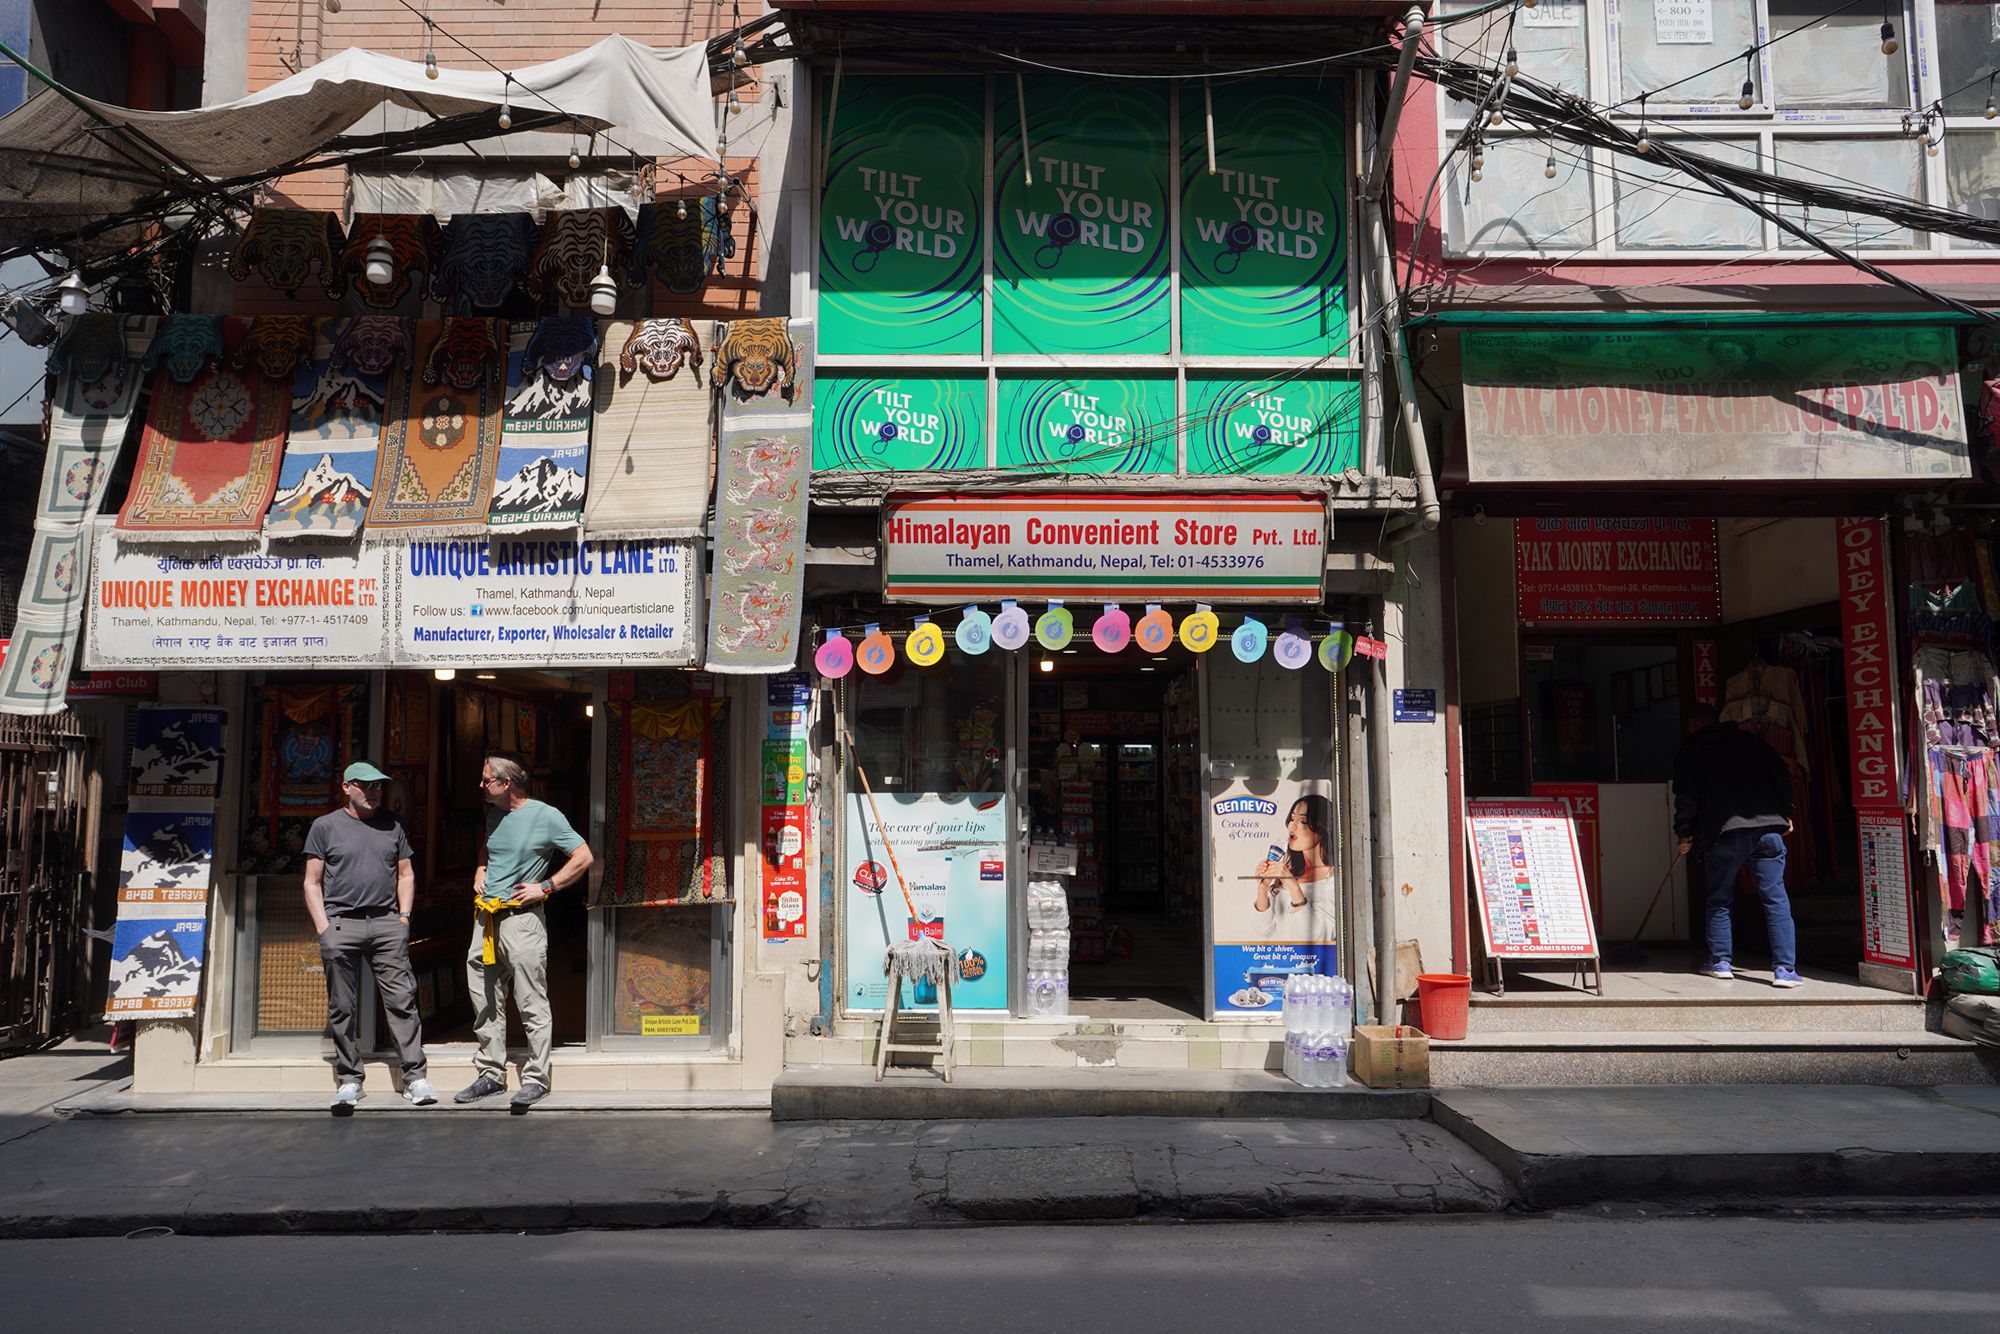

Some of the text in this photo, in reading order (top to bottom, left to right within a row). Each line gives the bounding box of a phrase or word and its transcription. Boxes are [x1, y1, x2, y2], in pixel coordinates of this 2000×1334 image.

[1670, 7, 1691, 15] 800
[858, 166, 922, 199] TILT
[1038, 156, 1106, 191] TILT
[1216, 168, 1280, 200] TILT
[874, 195, 965, 235] YOUR
[1056, 187, 1153, 228] YOUR
[1233, 197, 1325, 236] YOUR
[1470, 339, 1549, 348] HMG Authorised
[873, 389, 913, 410] TILT
[1060, 390, 1100, 412] TILT
[1246, 391, 1286, 412] TILT
[1479, 376, 1951, 437] YAK MONEY EXCHANGE P. LTD.
[884, 407, 940, 431] YOUR
[1071, 408, 1127, 433] YOUR
[1258, 409, 1313, 433] YOUR
[888, 517, 1322, 549] Himalayan Convenient Store Pvt. Ltd.
[658, 540, 679, 554] PVT.
[1521, 541, 1702, 571] YAK MONEY EXCHANGE
[410, 540, 654, 580] UNIQUE ARTISTIC LANE
[658, 558, 678, 573] LTD.
[946, 554, 1264, 571] Thamel, Kathmandu, Nepal, Tel: 01-4533976
[101, 579, 354, 611] UNIQUE MONEY EXCHANGE
[358, 579, 379, 591] PVT.
[476, 587, 615, 600] Thamel, Kathmandu, Nepal
[358, 593, 378, 606] LTD.
[413, 603, 674, 617] Follow us: www.facebook.com/uniqueartisticlane
[111, 617, 154, 628] Thamel,
[156, 616, 221, 628] Kathmandu,
[224, 616, 257, 628] Nepal,
[260, 616, 278, 626] Tel:
[323, 614, 368, 625] 4517409
[413, 624, 673, 644] Manufacturer, Exporter, Wholesaler & Retailer
[1697, 642, 1719, 686] YAK
[116, 676, 148, 688] Club
[1852, 622, 1888, 799] EXCHANGE
[1486, 808, 1506, 817] MONEY
[1507, 808, 1541, 817] EXCHANGE
[1860, 816, 1902, 825] MONEY EXCHANGE
[868, 822, 897, 832] Take
[923, 822, 936, 834] of
[936, 825, 964, 835] your
[965, 822, 985, 834] lips
[1221, 819, 1259, 829] Cookies
[900, 838, 923, 846] using
[924, 927, 943, 936] Balm
[1275, 945, 1295, 953] shiver,
[959, 958, 984, 969] 100%
